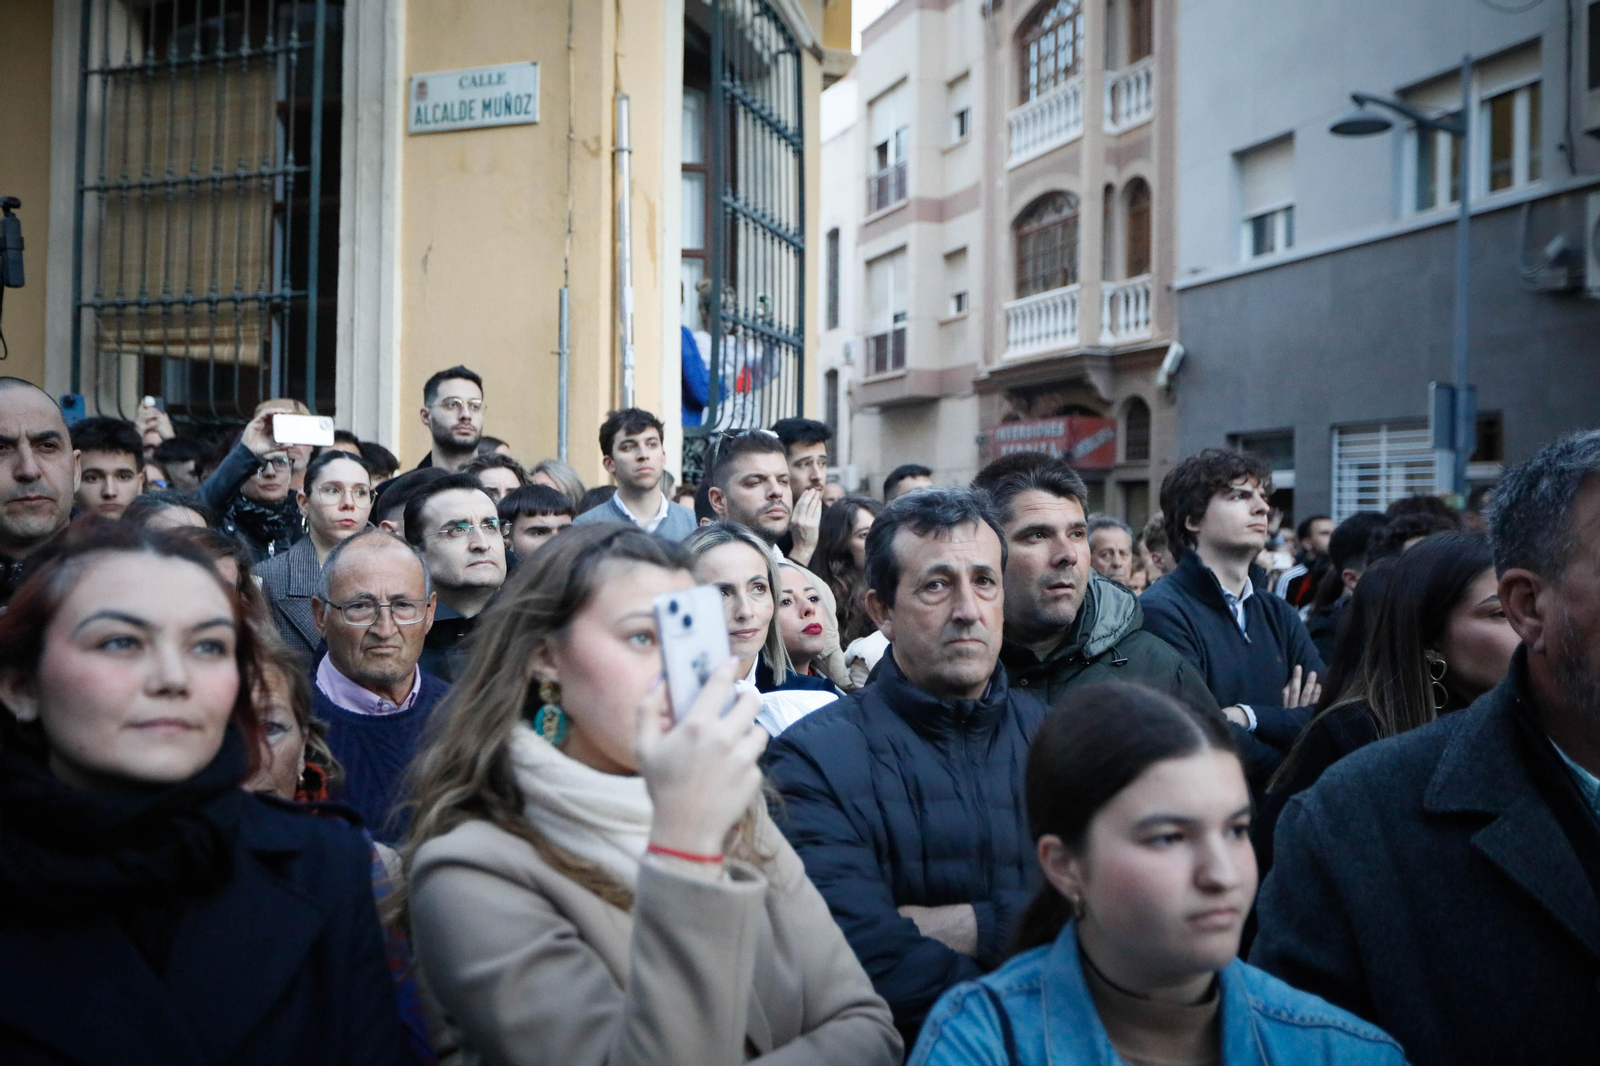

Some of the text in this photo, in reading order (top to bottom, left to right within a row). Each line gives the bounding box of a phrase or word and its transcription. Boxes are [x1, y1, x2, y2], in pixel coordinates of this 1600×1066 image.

[458, 71, 507, 89] CALLE
[414, 92, 533, 126] ALCALDE MUÑOZ
